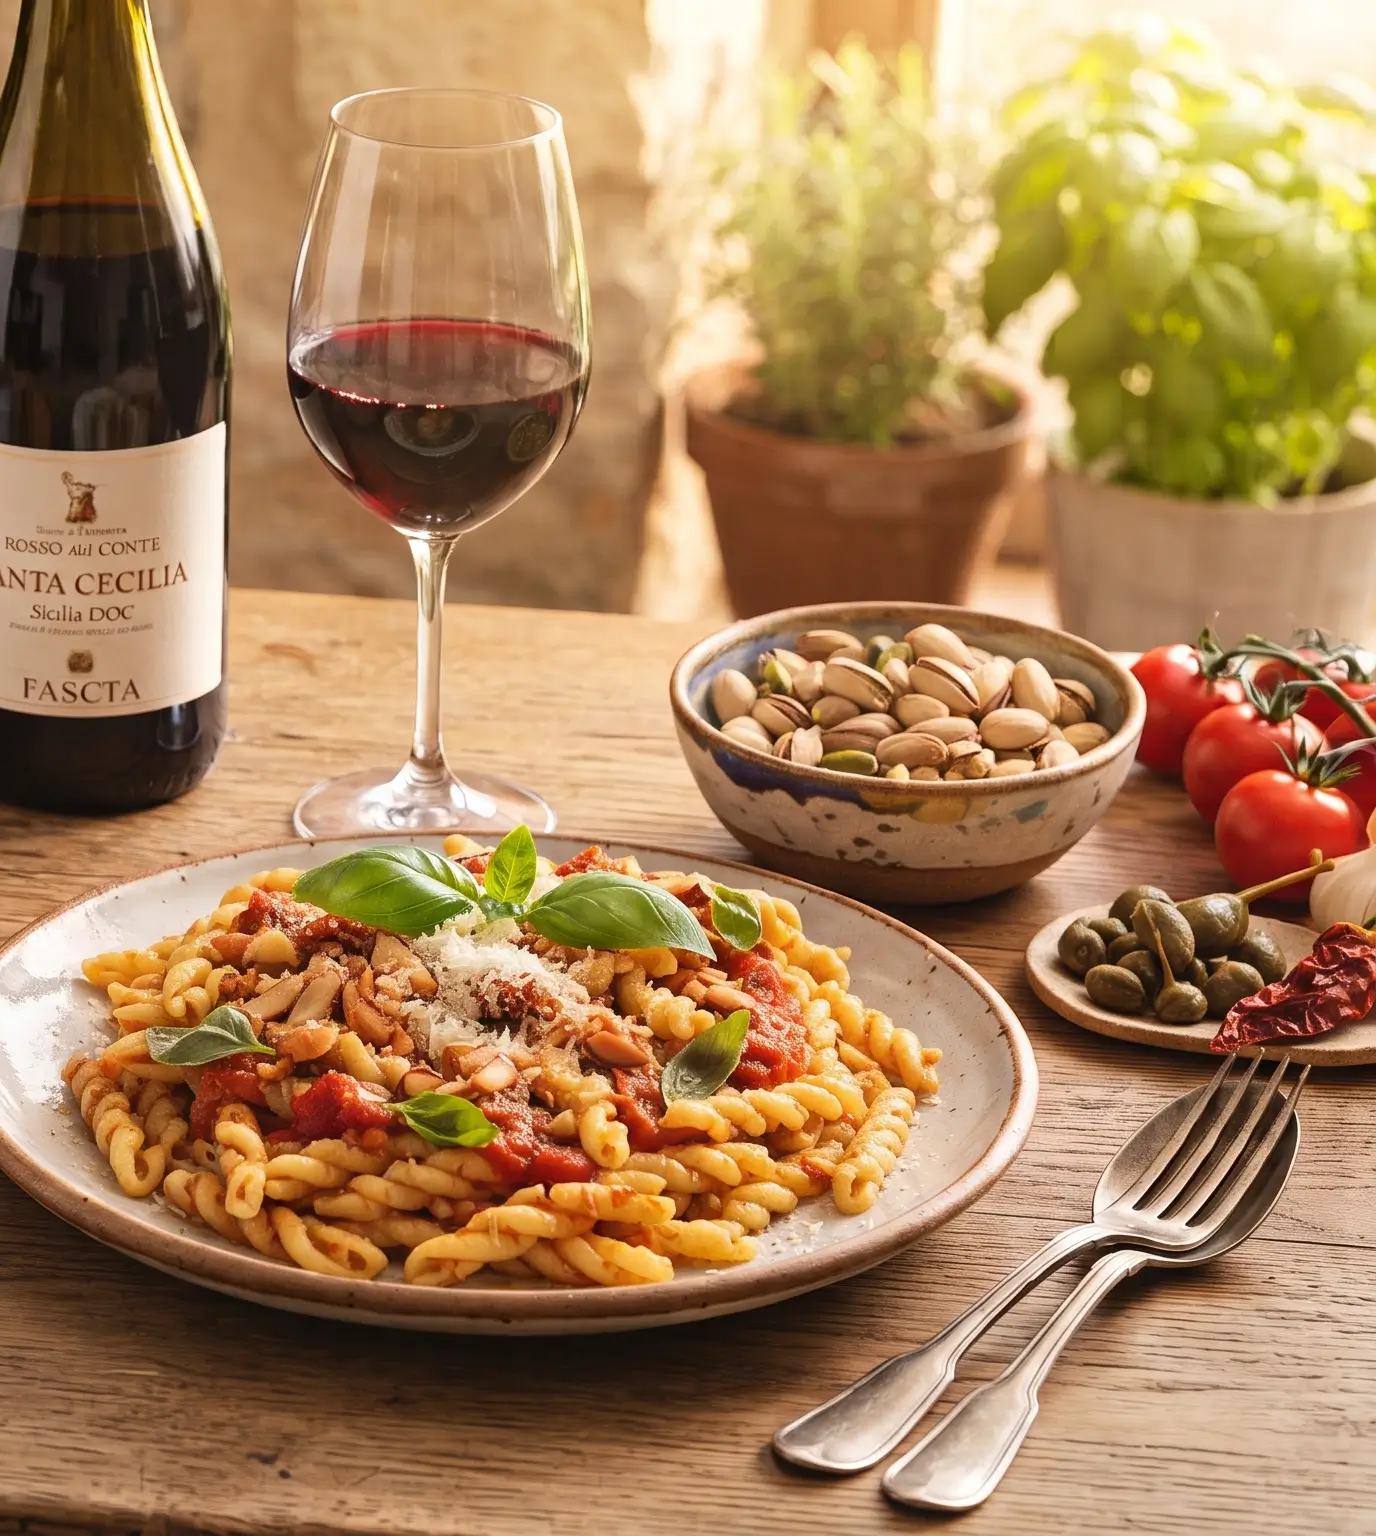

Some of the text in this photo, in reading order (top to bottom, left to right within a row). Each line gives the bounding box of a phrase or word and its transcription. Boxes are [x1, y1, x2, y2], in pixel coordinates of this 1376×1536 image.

[5, 536, 63, 556] ROSSO
[98, 537, 161, 557] CONTE
[74, 561, 189, 596] CECILIA
[29, 604, 135, 622] Sicilia DOC
[23, 677, 141, 704] FASCTA
